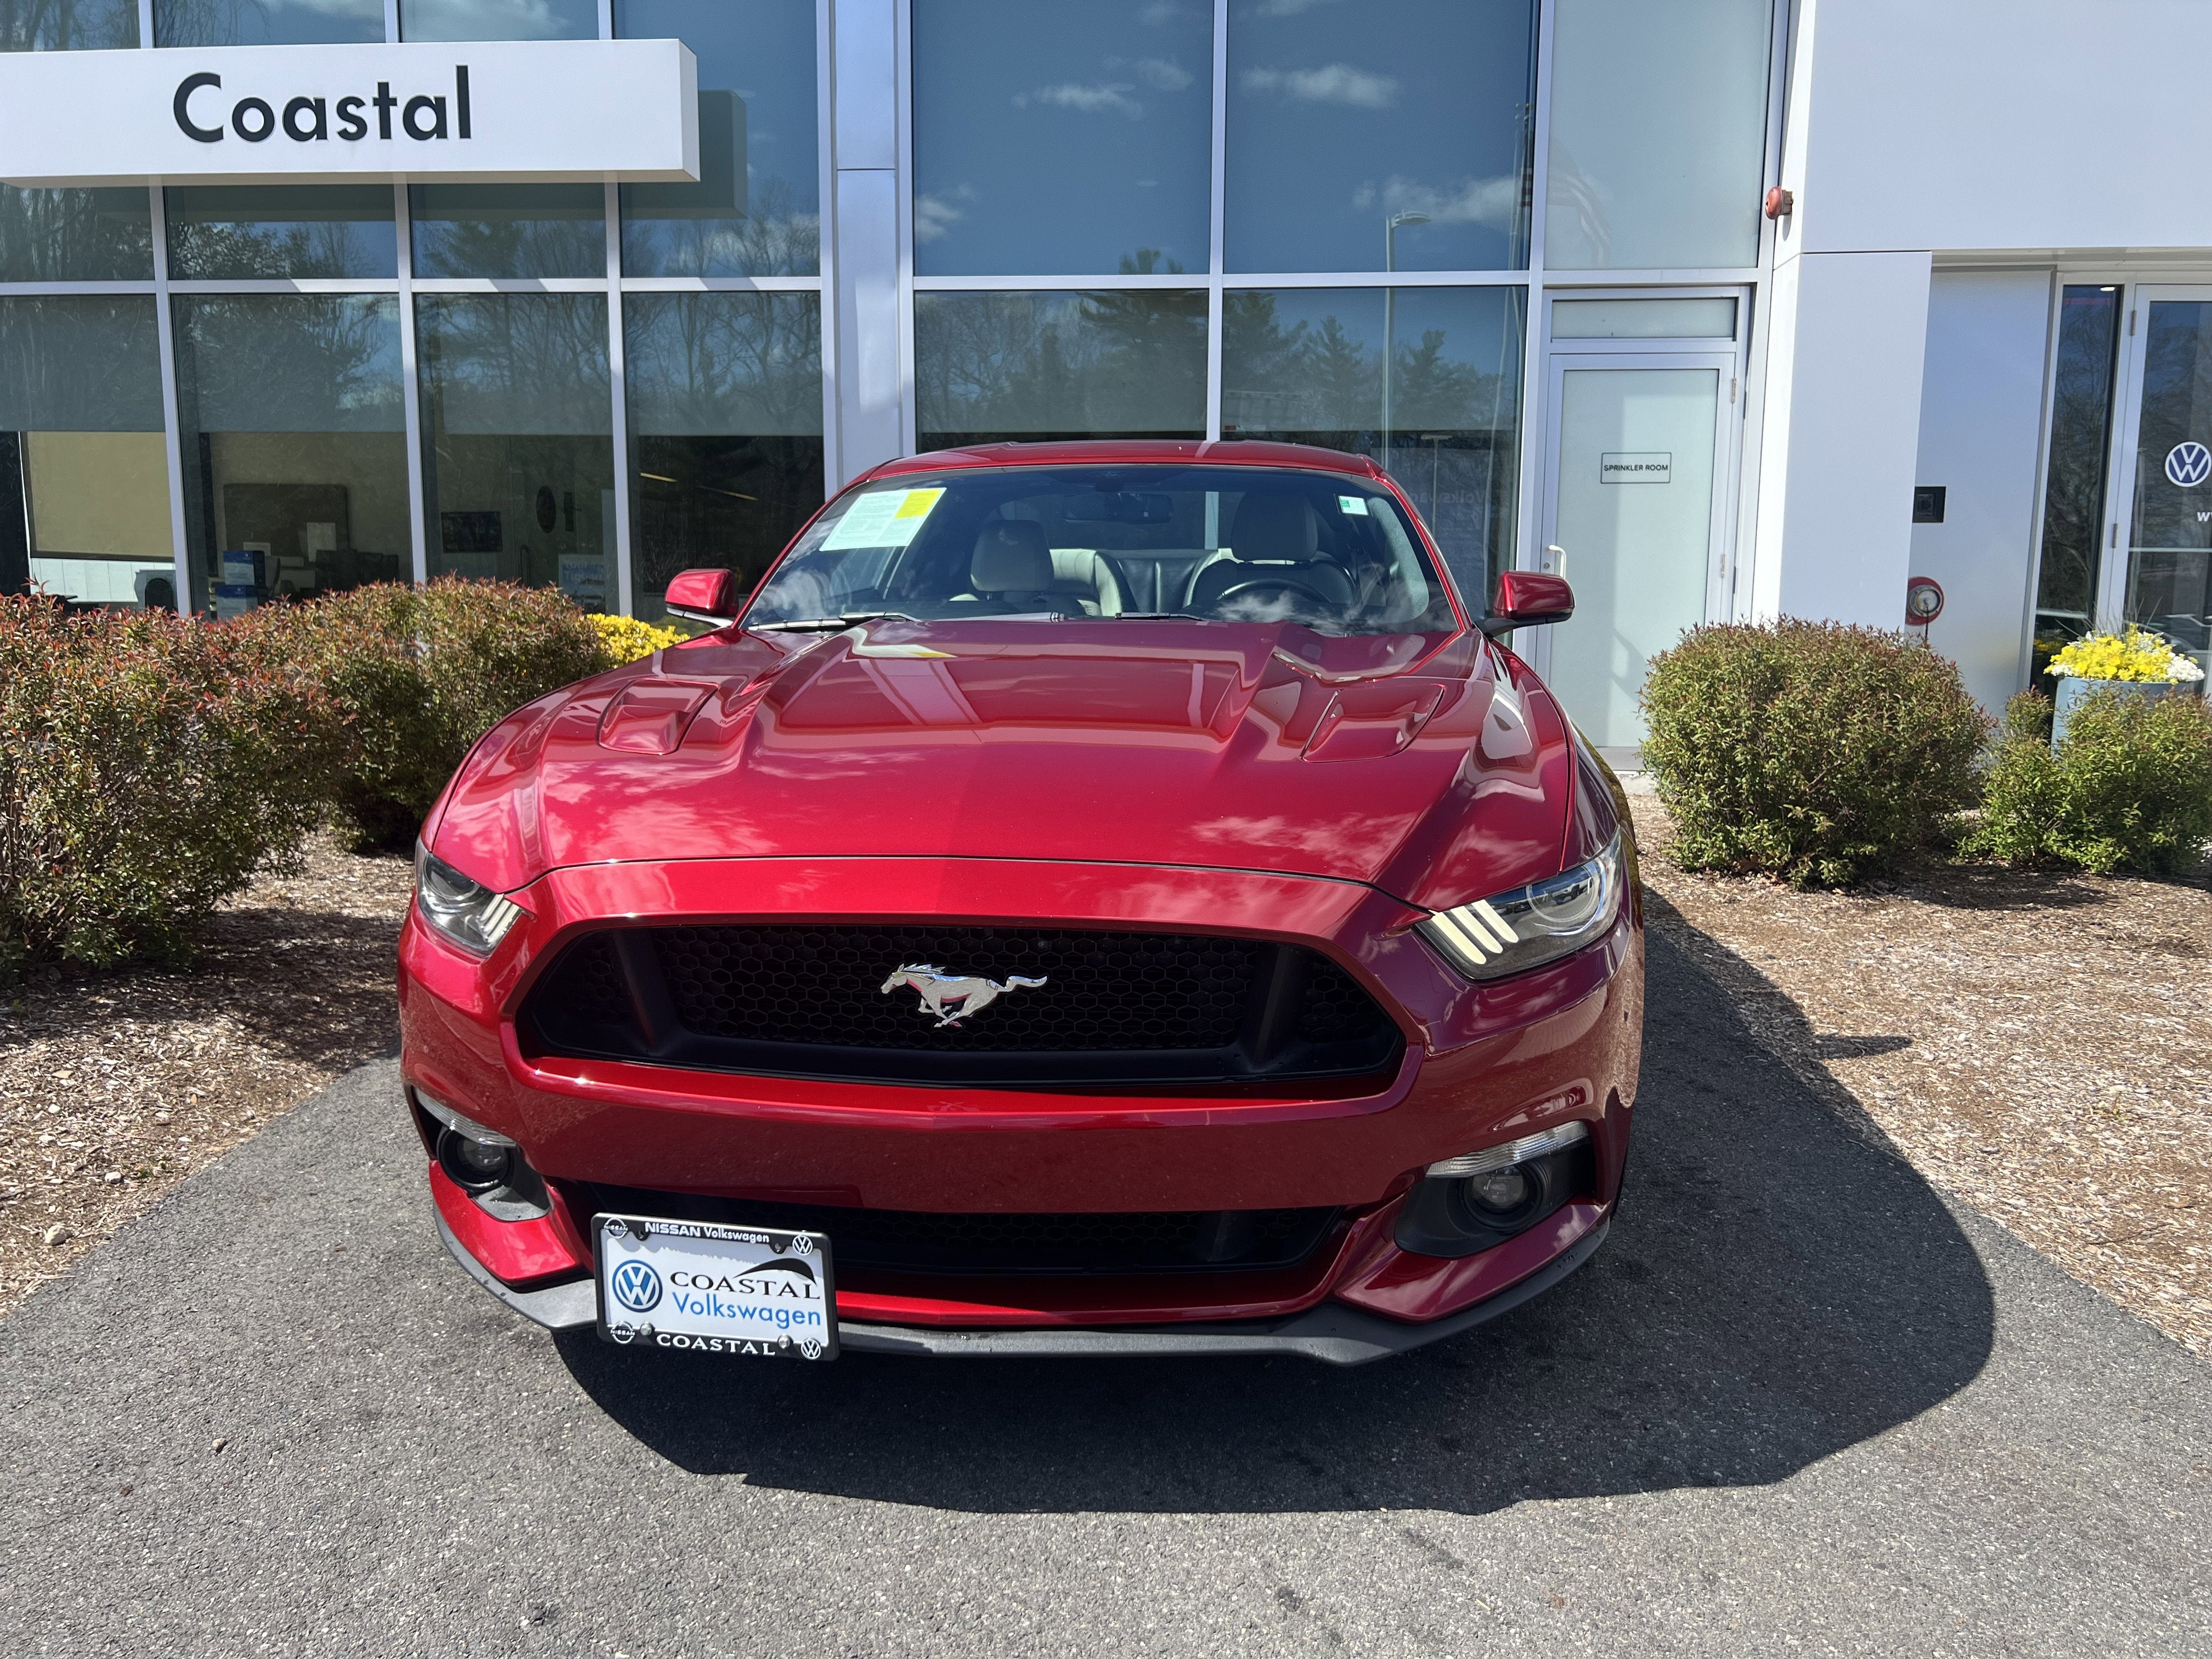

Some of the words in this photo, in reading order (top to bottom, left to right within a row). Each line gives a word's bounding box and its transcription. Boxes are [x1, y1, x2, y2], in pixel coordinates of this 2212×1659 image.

[173, 65, 472, 142] Coastal
[645, 1222, 700, 1237] NISSAN
[704, 1226, 769, 1244] Volkswagen
[670, 1272, 820, 1299] COASTAL
[672, 1292, 820, 1329] Volkswagen
[656, 1334, 775, 1356] COASTAL
